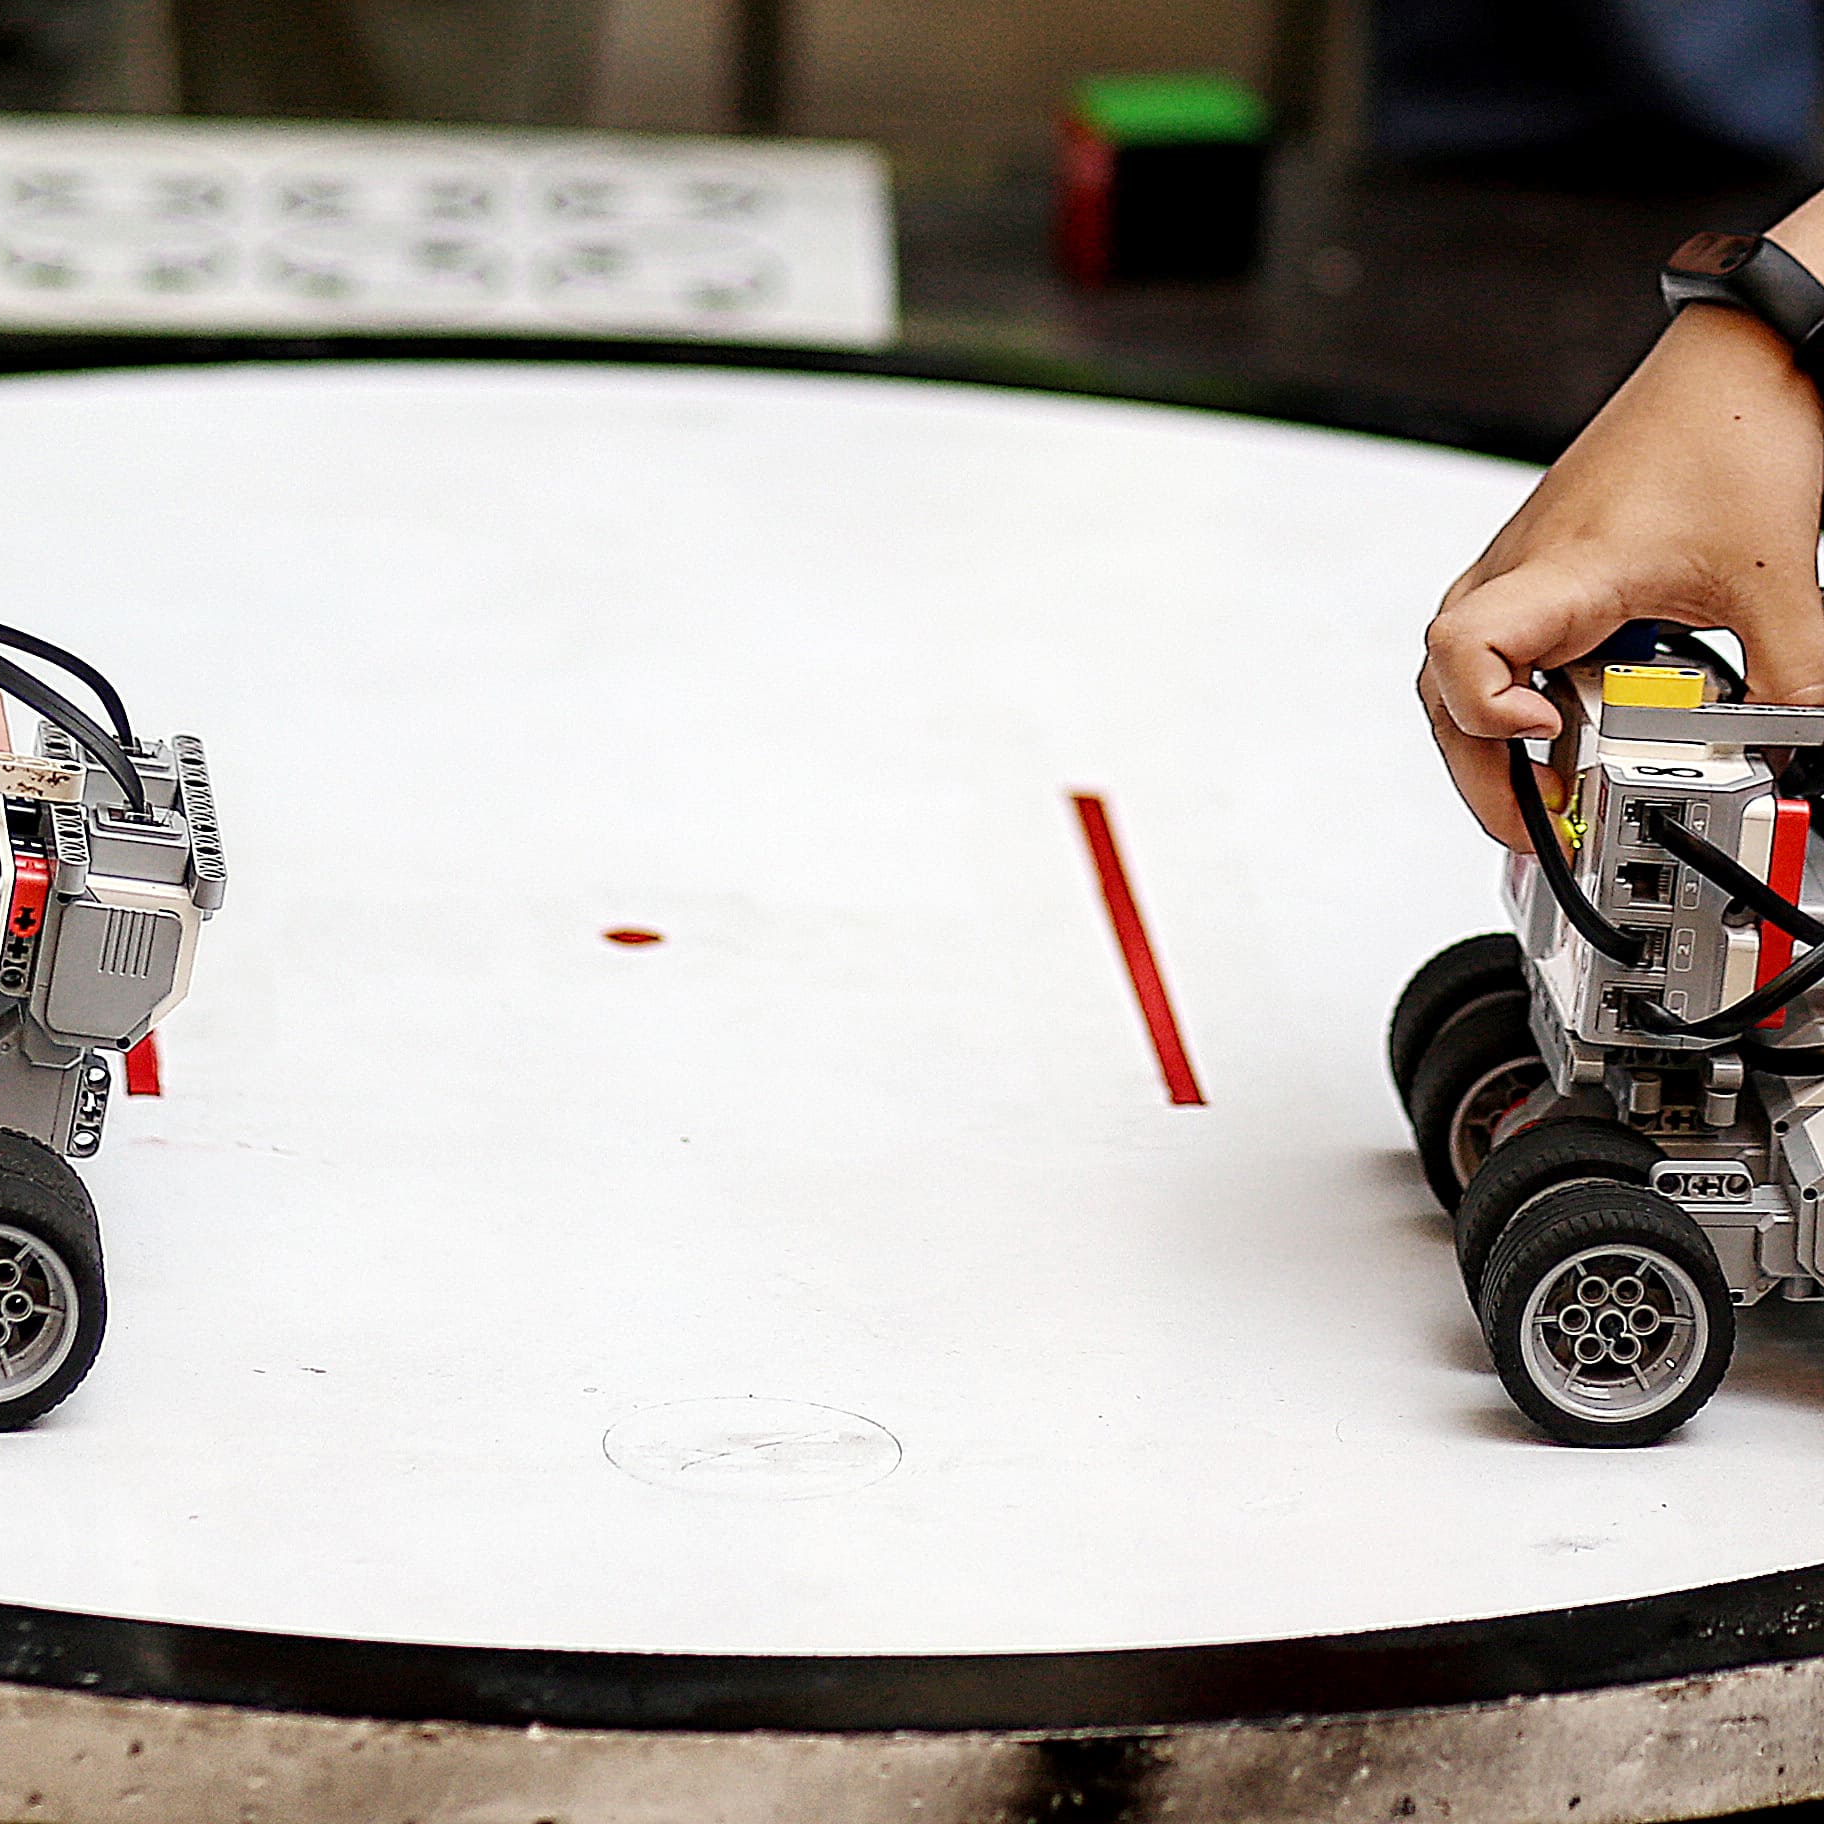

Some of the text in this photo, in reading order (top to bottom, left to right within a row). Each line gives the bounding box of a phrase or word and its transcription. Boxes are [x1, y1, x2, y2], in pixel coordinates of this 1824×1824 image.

[1677, 944, 1691, 956] 2
[1685, 881, 1698, 894] 3
[1692, 819, 1706, 832] 4
